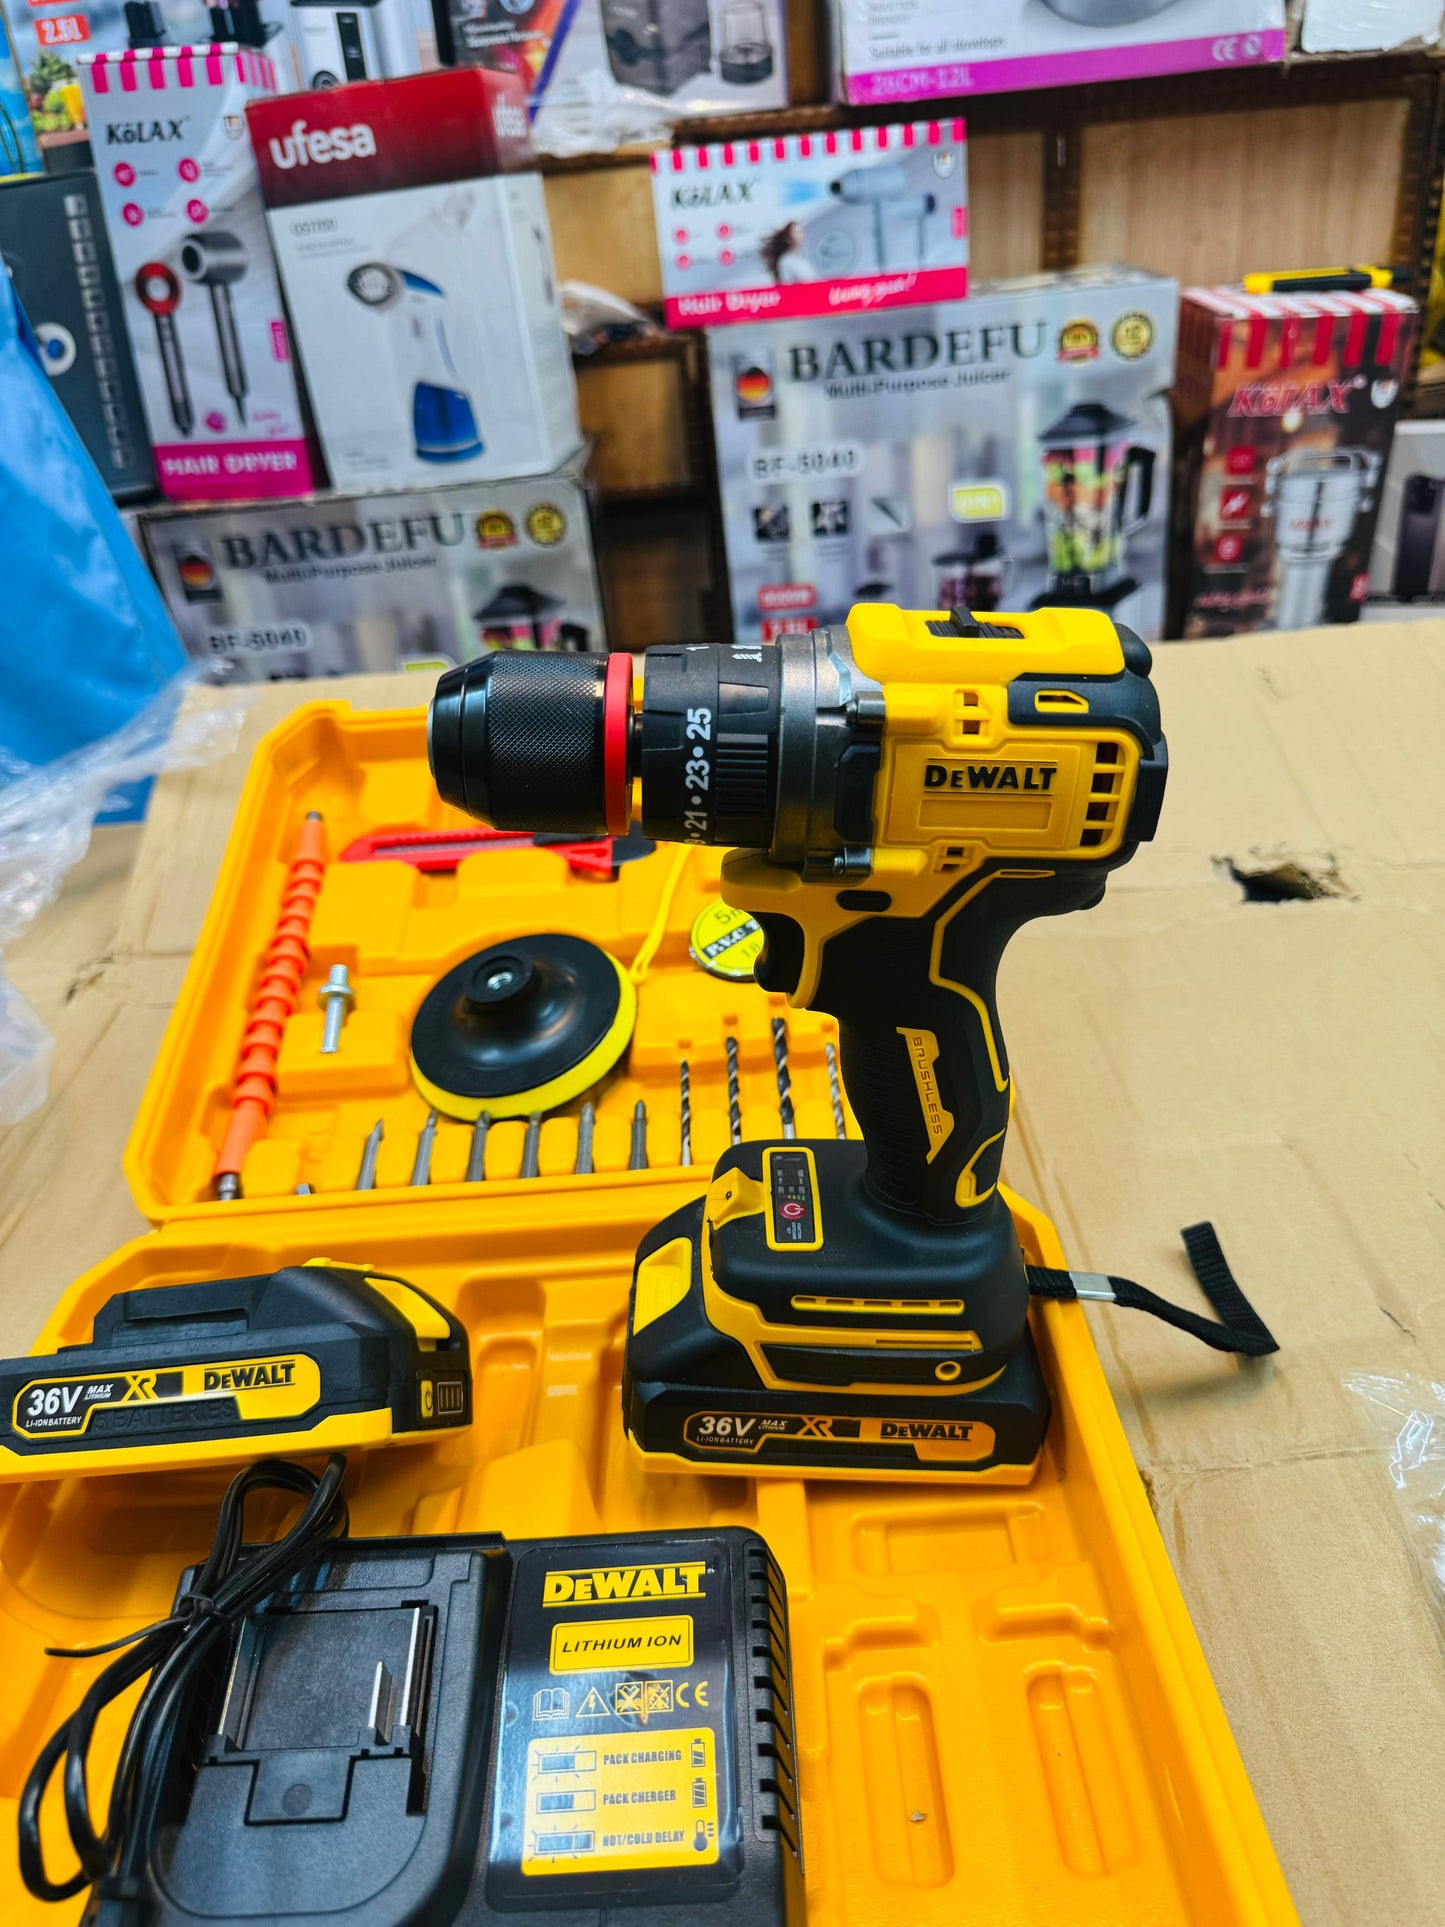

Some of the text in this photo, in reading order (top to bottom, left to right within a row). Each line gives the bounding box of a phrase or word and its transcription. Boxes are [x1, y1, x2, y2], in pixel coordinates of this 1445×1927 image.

[268, 119, 378, 169] ufesa
[788, 320, 1047, 383] BARDEFU
[162, 449, 298, 476] HAIR DRYER
[221, 511, 465, 570] BARDEFU
[686, 707, 712, 741] 25
[685, 759, 710, 791] 23
[684, 810, 707, 830] 21
[912, 1036, 943, 1135] BRUSHLESS
[27, 1385, 83, 1417] 36V
[86, 1383, 114, 1395] MAX
[120, 1373, 158, 1402] XR
[84, 1392, 112, 1401] LITHIUM
[698, 1415, 757, 1437] 36V
[759, 1418, 788, 1427] MAX
[797, 1416, 835, 1438] XR
[562, 1634, 682, 1653] LITHIUM ION
[603, 1749, 682, 1765] PACK CHARGING
[603, 1789, 676, 1805] PACK CHERGER
[602, 1830, 685, 1847] HOT/COLD DELAY
